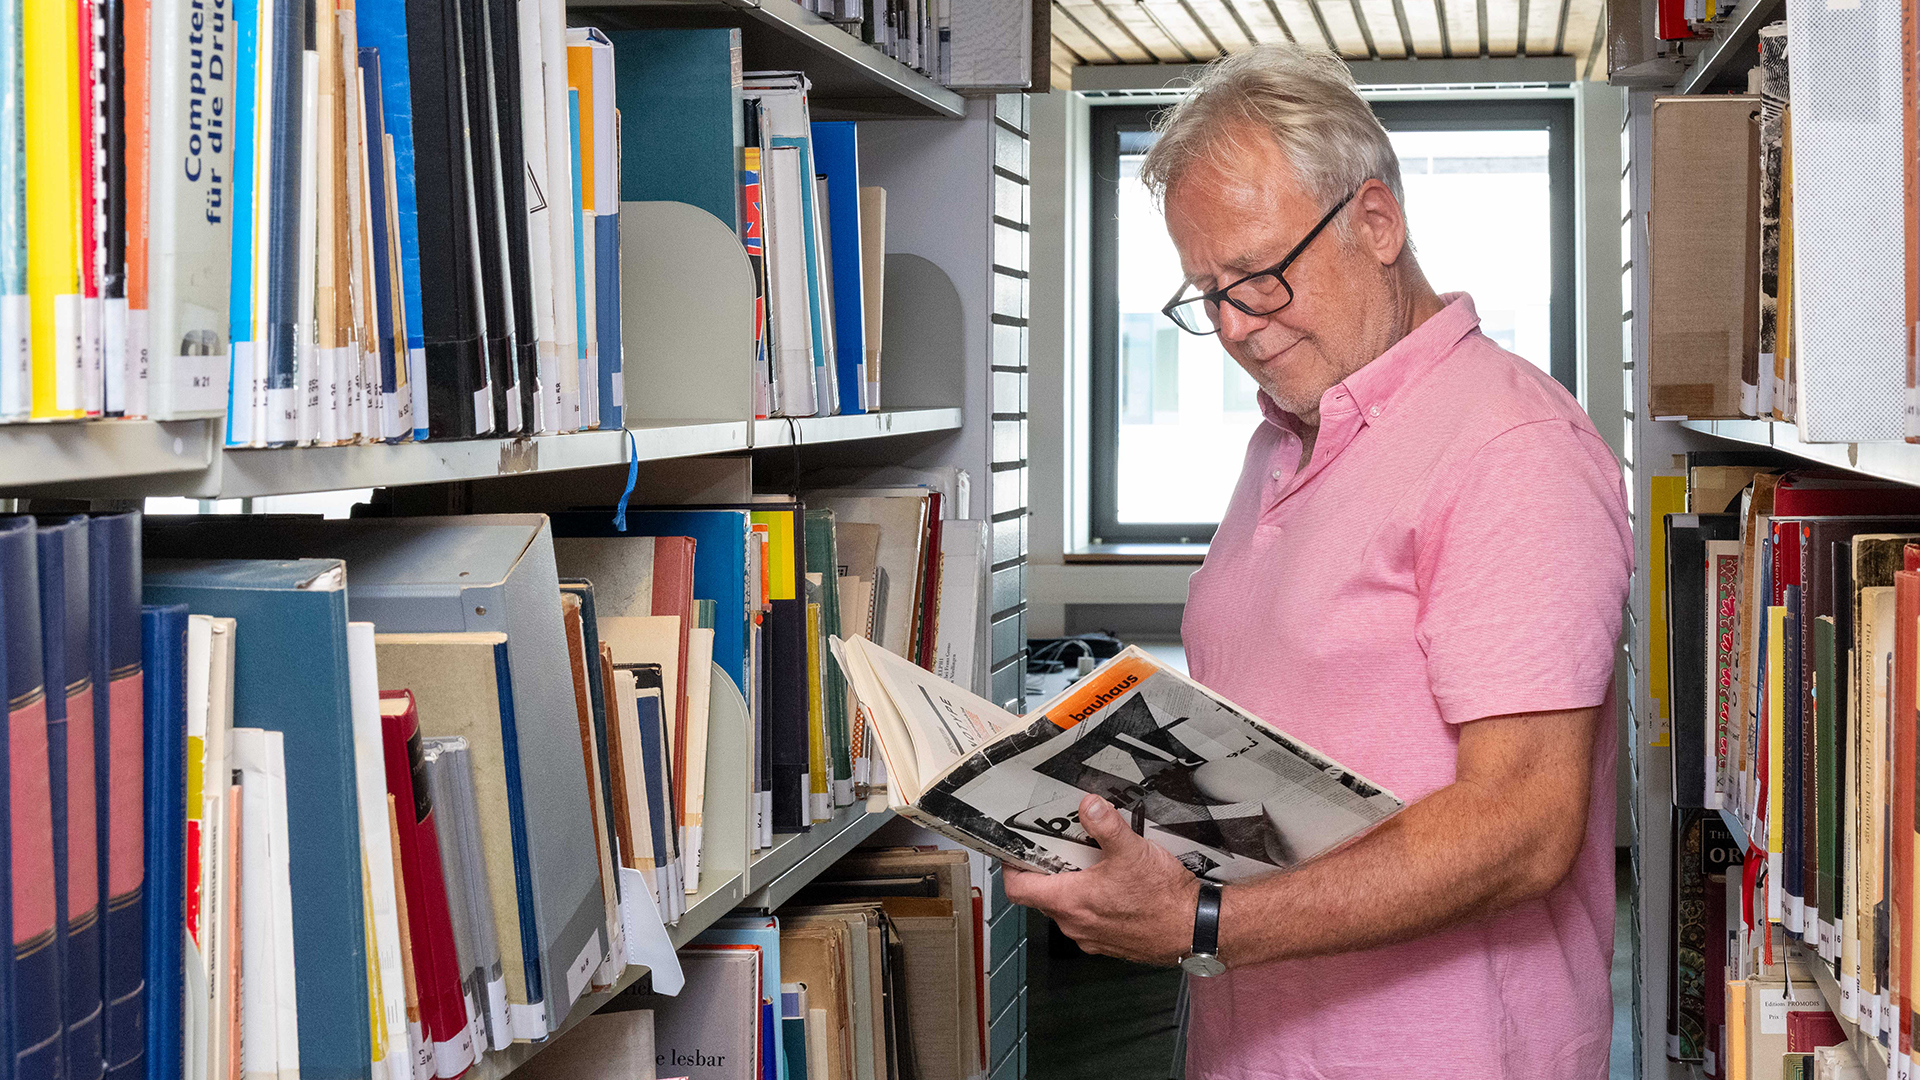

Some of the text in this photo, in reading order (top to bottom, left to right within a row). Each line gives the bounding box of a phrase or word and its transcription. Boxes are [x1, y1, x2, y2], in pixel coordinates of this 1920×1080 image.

[207, 96, 223, 154] die
[206, 168, 222, 226] für
[140, 348, 148, 379] Ik 20
[193, 376, 210, 387] Ik 21
[1801, 541, 1809, 579] New
[1801, 580, 1809, 659] Directions
[1801, 662, 1810, 677] in
[1069, 674, 1138, 722] bauhaus
[1801, 679, 1810, 783] Bookbinding
[1865, 721, 1872, 737] of
[1864, 790, 1872, 845] Bindings
[1709, 847, 1742, 864] OR
[671, 1048, 726, 1067] lesbar
